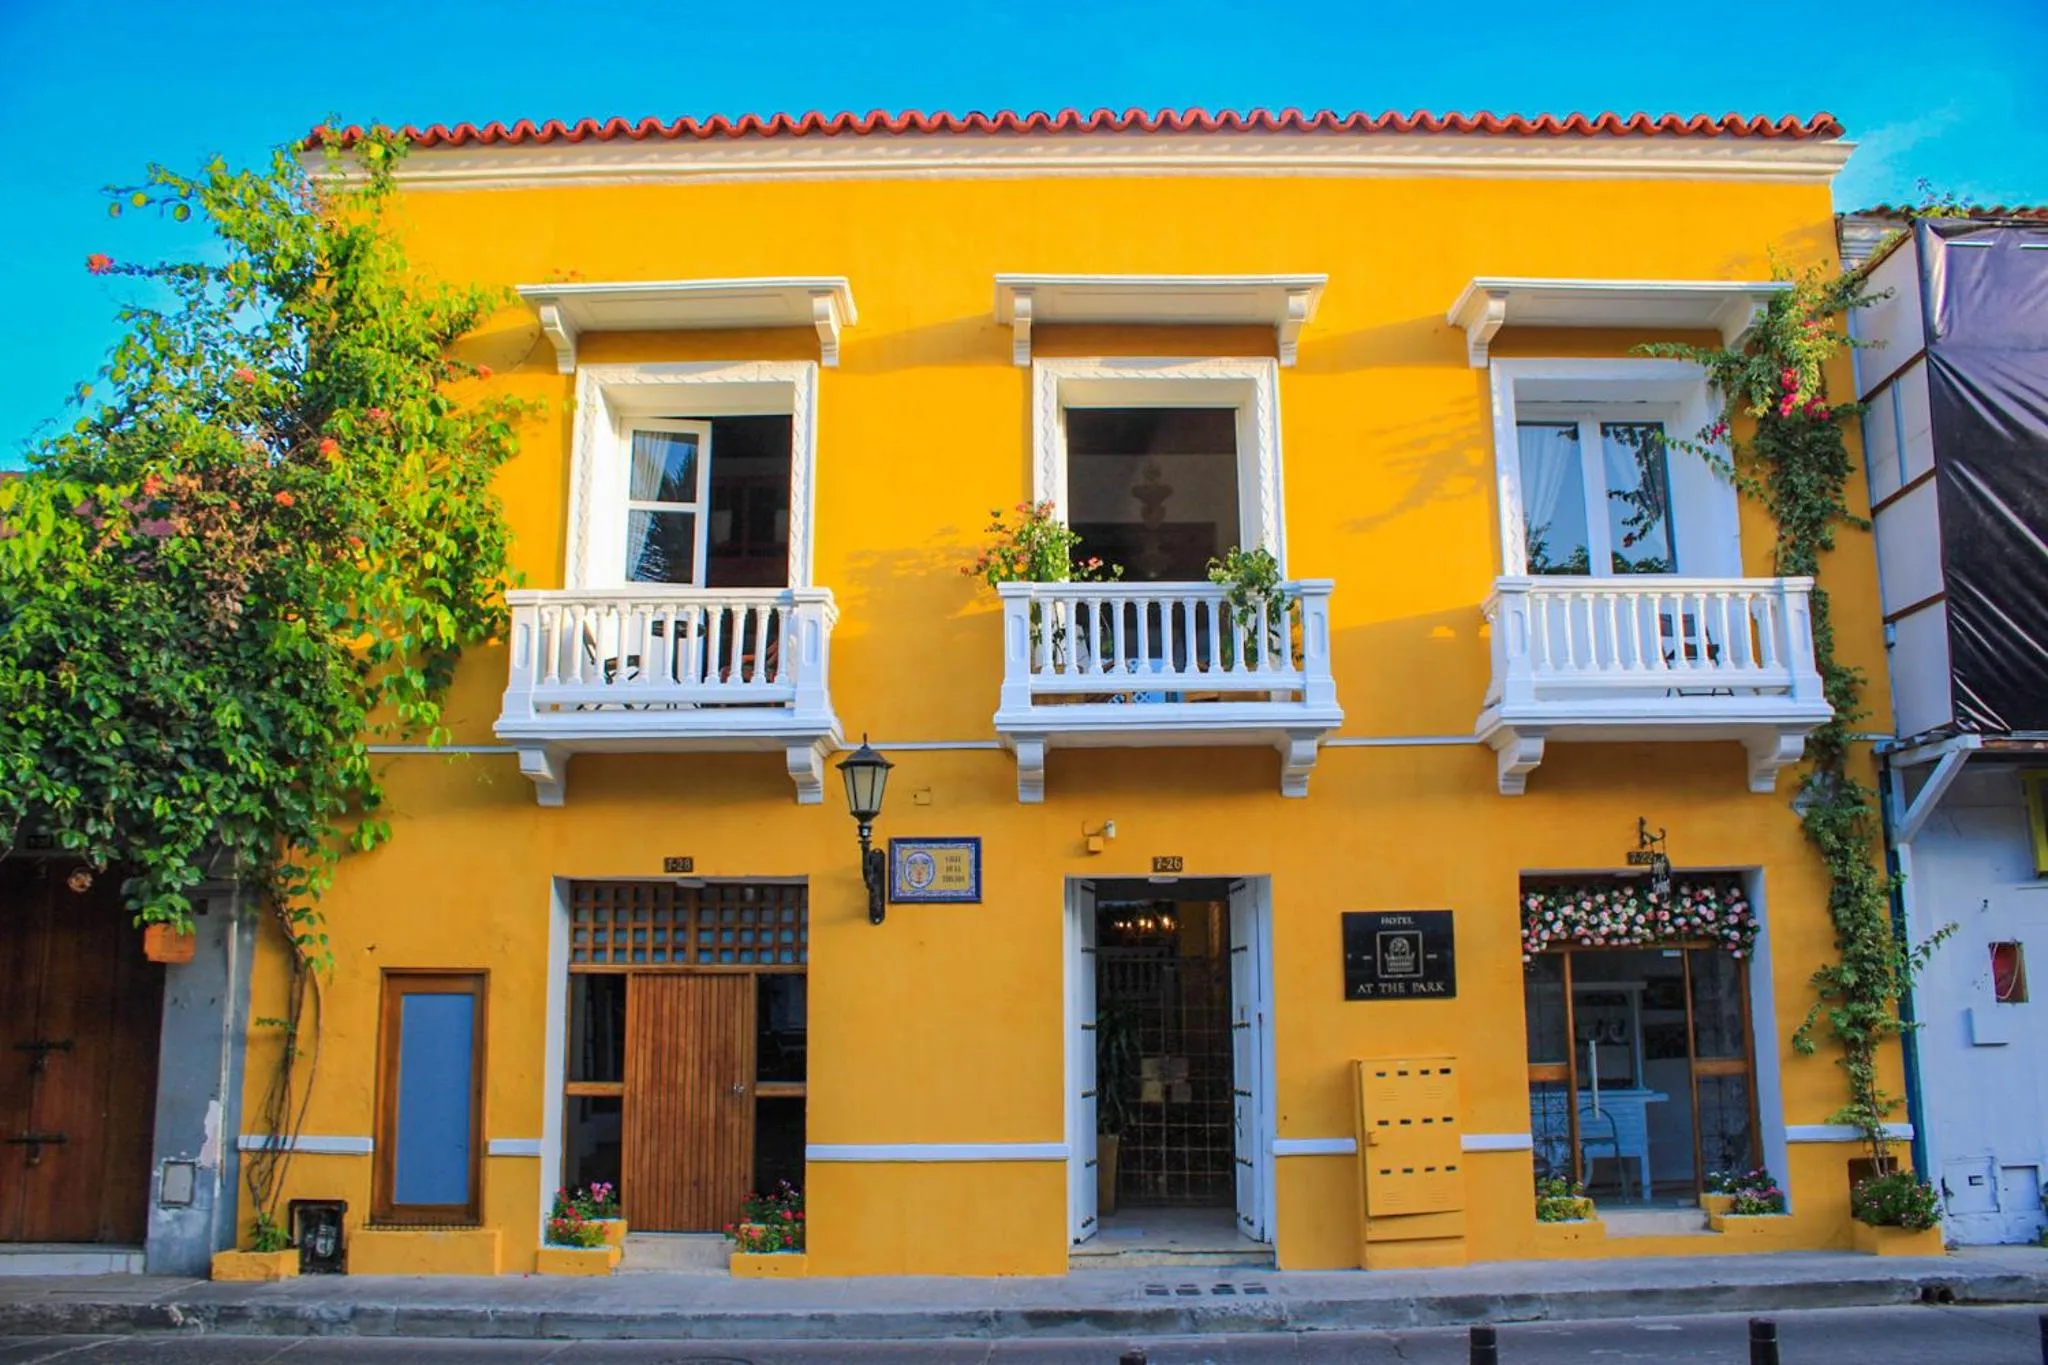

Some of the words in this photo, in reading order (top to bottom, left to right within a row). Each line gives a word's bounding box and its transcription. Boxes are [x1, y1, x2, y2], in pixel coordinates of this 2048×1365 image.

[1380, 916, 1414, 925] HOTEL
[1358, 984, 1374, 993] AT
[1379, 983, 1405, 992] THE
[1412, 982, 1445, 992] PARK
